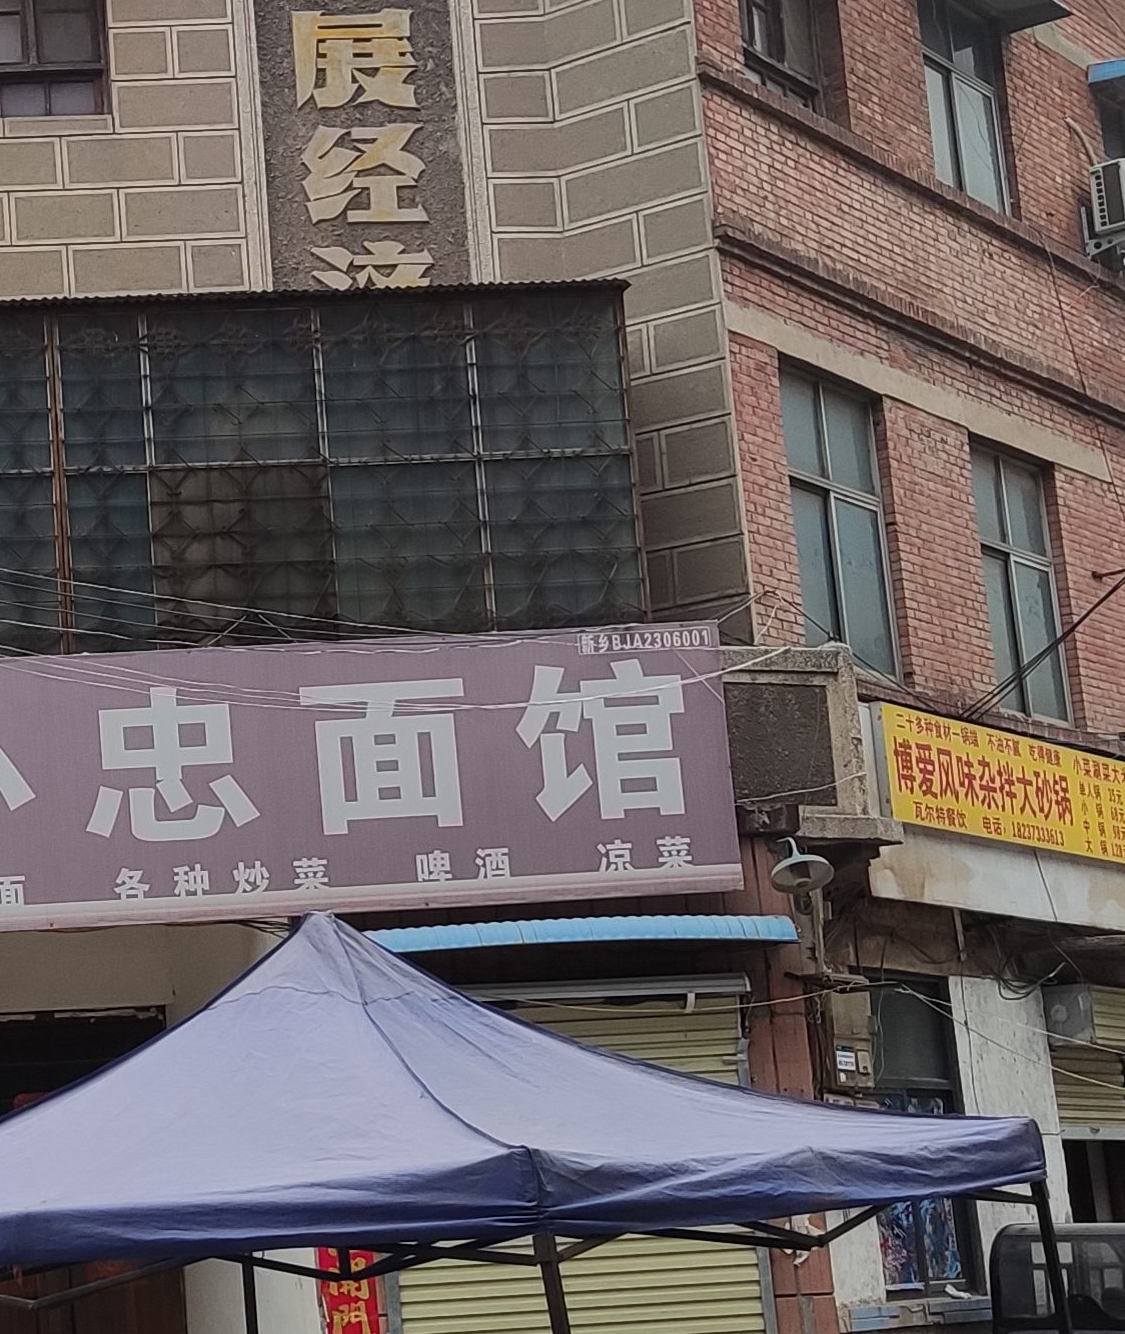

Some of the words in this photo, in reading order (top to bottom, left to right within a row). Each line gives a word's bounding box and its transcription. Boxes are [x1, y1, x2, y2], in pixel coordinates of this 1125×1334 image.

[581, 629, 709, 653] 新乡BJA2306001
[893, 736, 1074, 827] 博爱风味杂拌大砂锅
[114, 857, 330, 900] 各种炒菜
[415, 847, 512, 882] 啤酒
[596, 836, 694, 873] 凉菜
